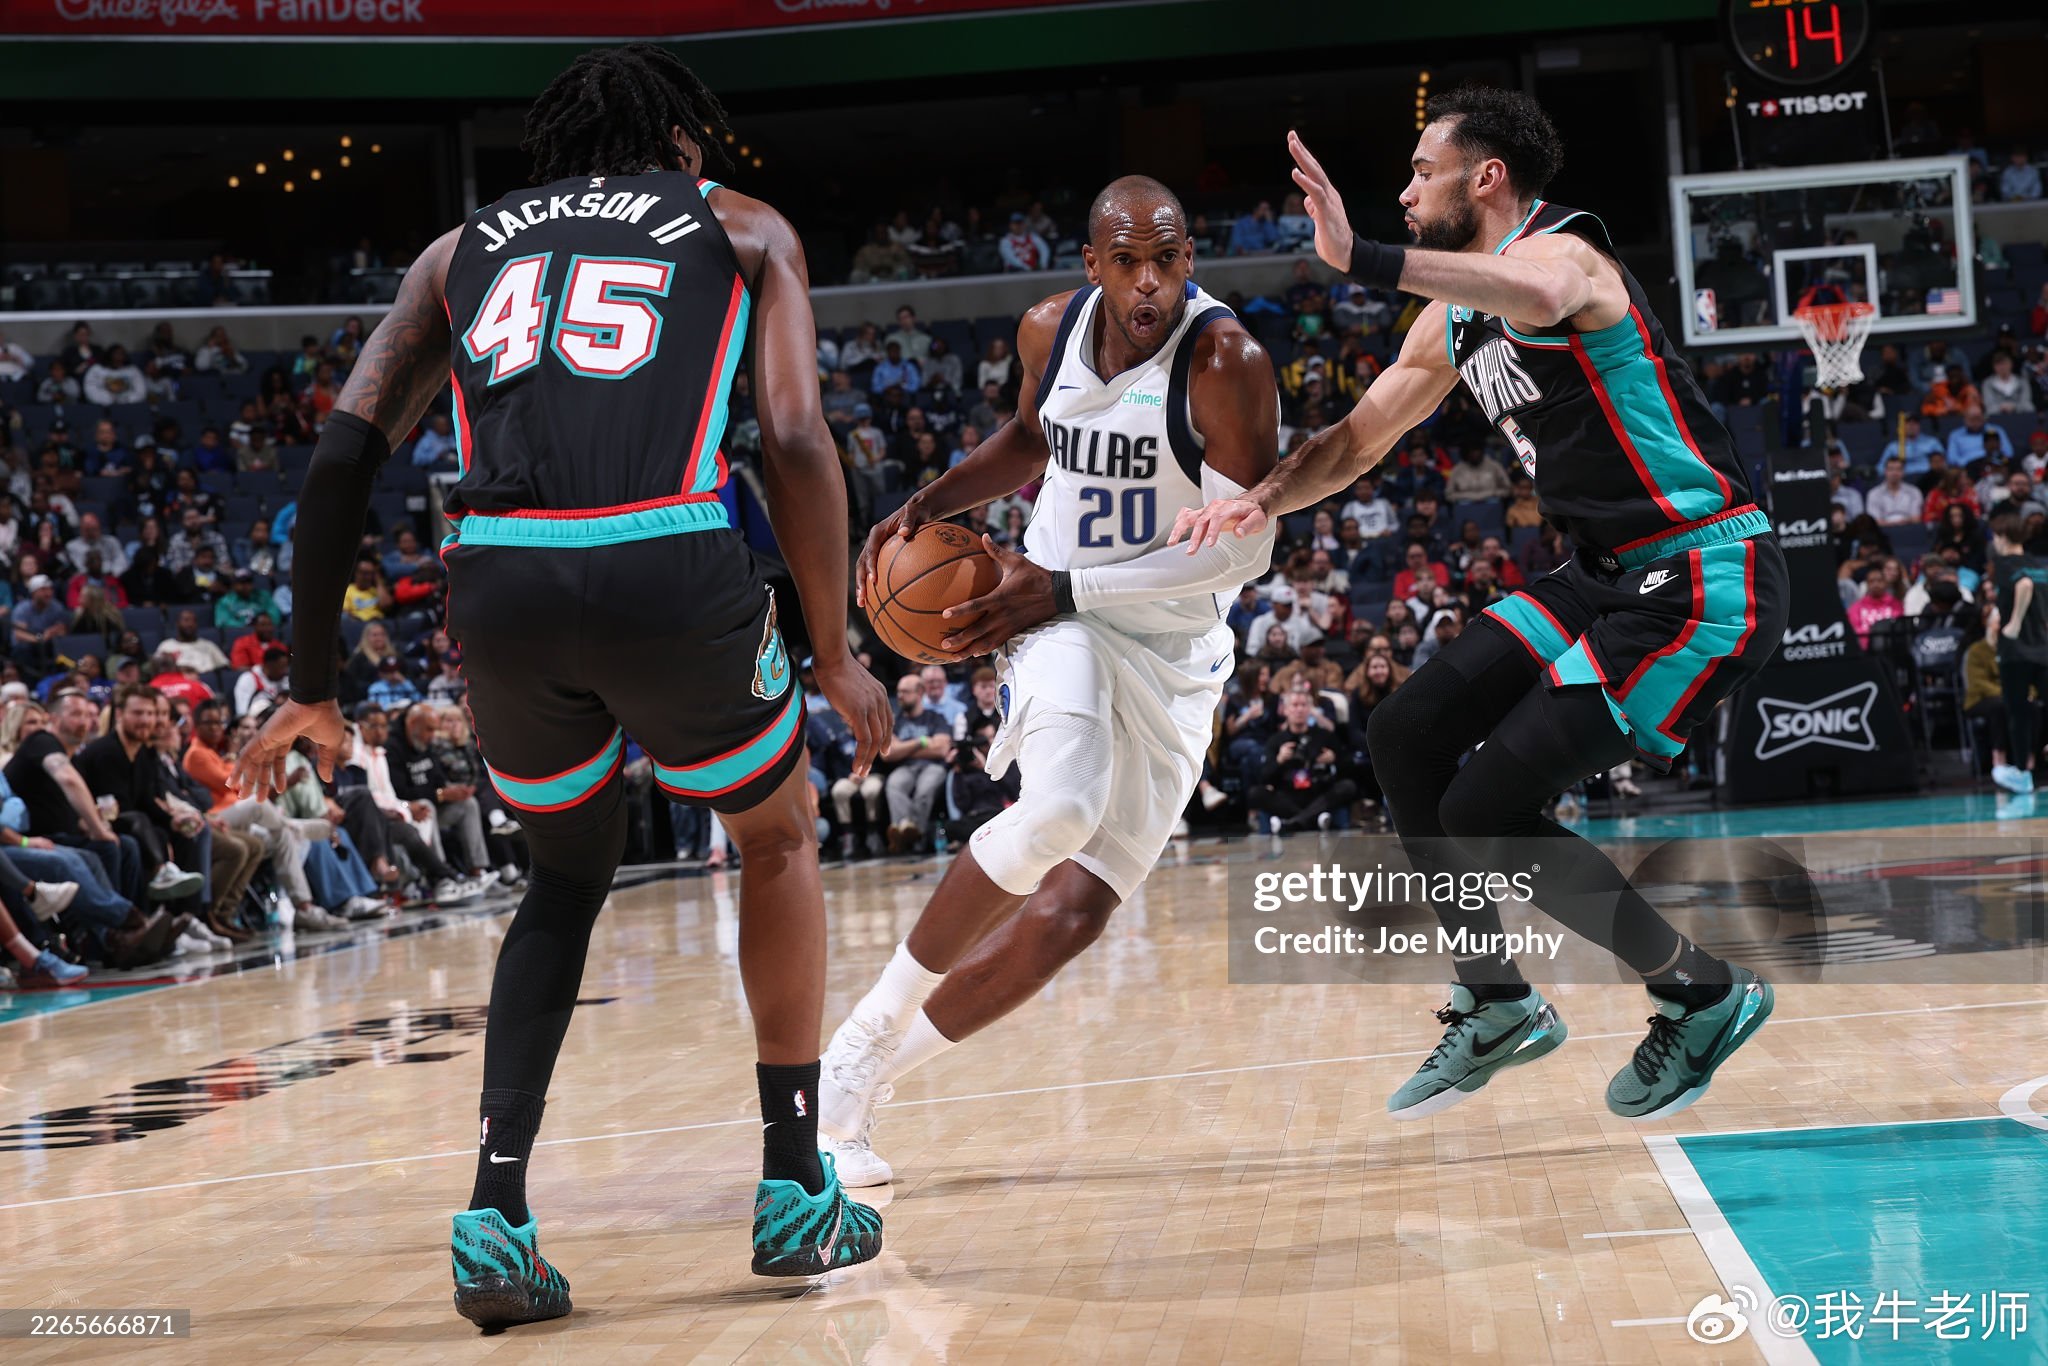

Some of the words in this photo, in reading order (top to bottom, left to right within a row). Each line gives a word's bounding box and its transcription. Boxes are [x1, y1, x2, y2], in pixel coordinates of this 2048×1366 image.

[254, 0, 424, 23] FanDeck
[1786, 3, 1844, 69] 14
[1779, 91, 1868, 116] TISSOT
[476, 191, 662, 252] JACKSON
[648, 213, 702, 246] II
[461, 250, 677, 387] 45
[1122, 389, 1163, 408] chime
[1078, 485, 1158, 549] 20
[1780, 533, 1828, 549] GOSSETT
[1644, 569, 1670, 586] NIKE
[1783, 640, 1847, 662] GOSSETT
[1770, 706, 1862, 739] SONIC
